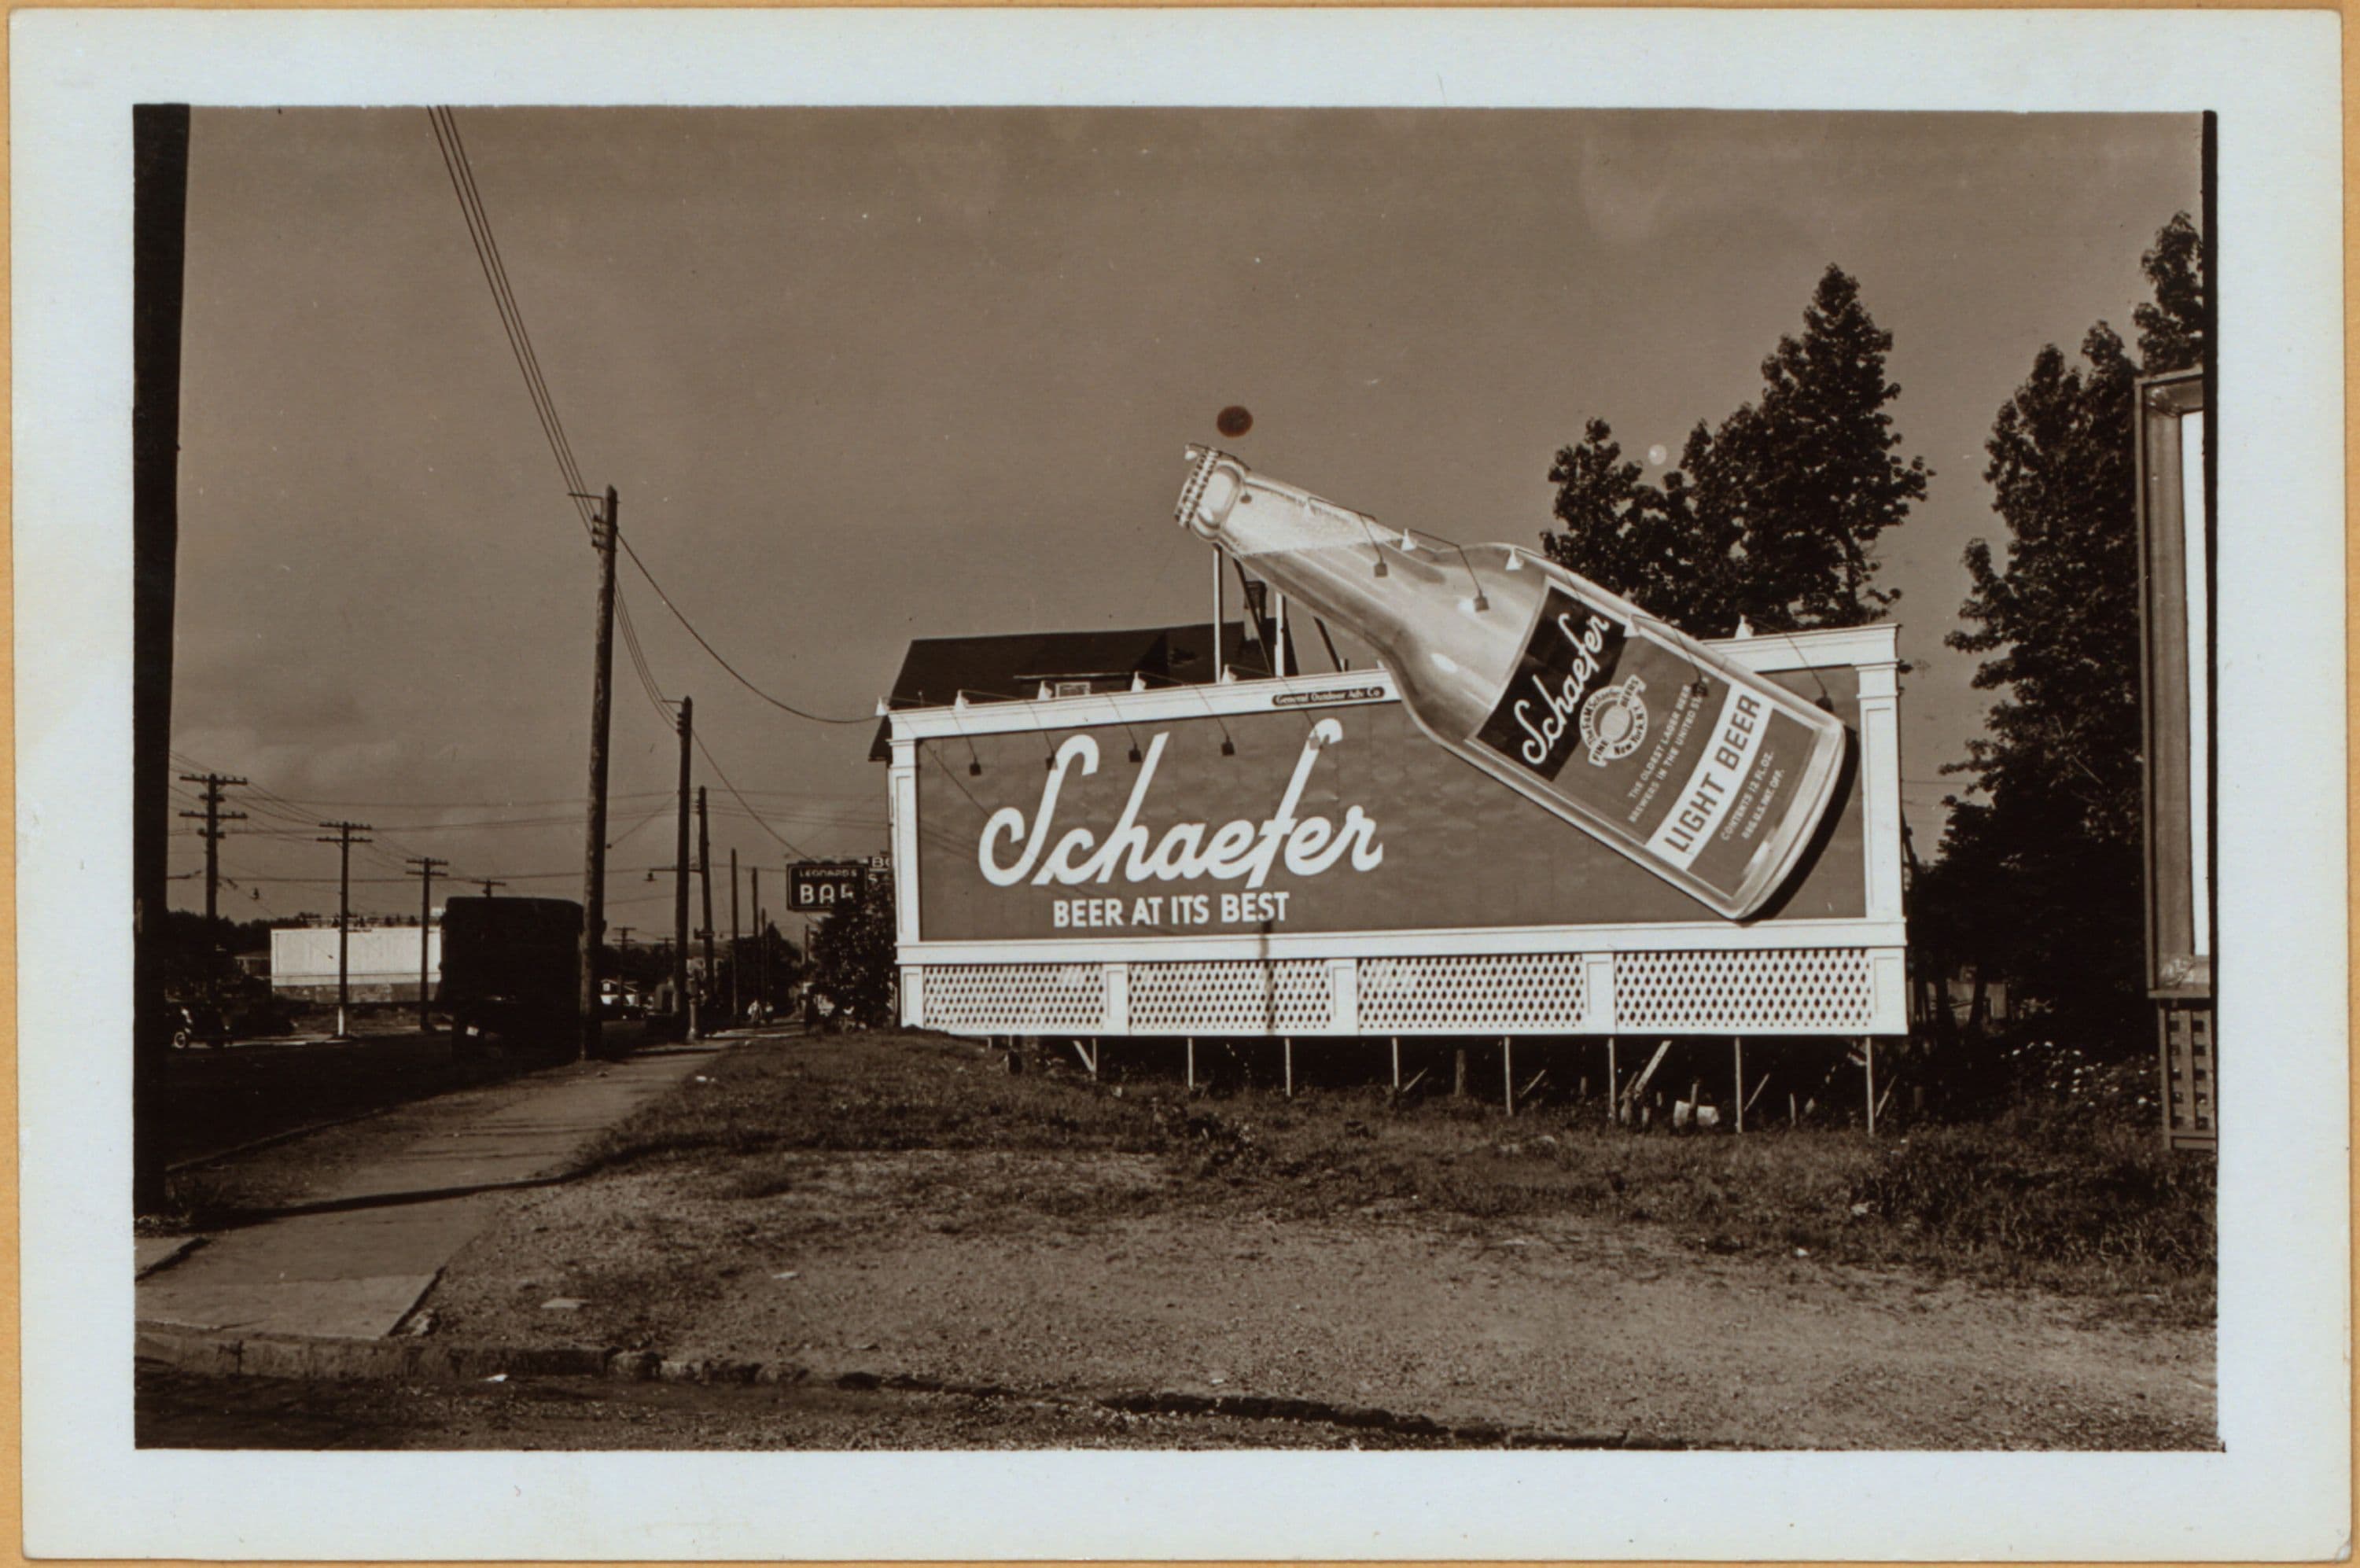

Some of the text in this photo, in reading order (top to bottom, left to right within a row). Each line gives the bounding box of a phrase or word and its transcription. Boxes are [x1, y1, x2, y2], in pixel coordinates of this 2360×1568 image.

[1514, 613, 1611, 765] Schaefer
[1628, 684, 1692, 799] THE OLDEST LAGER BEER
[978, 718, 1382, 888] Schaefer
[1592, 740, 1608, 761] FINE
[1628, 781, 1659, 823] BREWERS
[1655, 767, 1668, 780] IN
[1662, 747, 1680, 767] THE
[1675, 709, 1697, 745] UNITED
[1663, 695, 1762, 853] LIGHT BEER
[1720, 793, 1754, 841] CONTENTS
[1054, 892, 1289, 927] BEER AT ITS BEST
